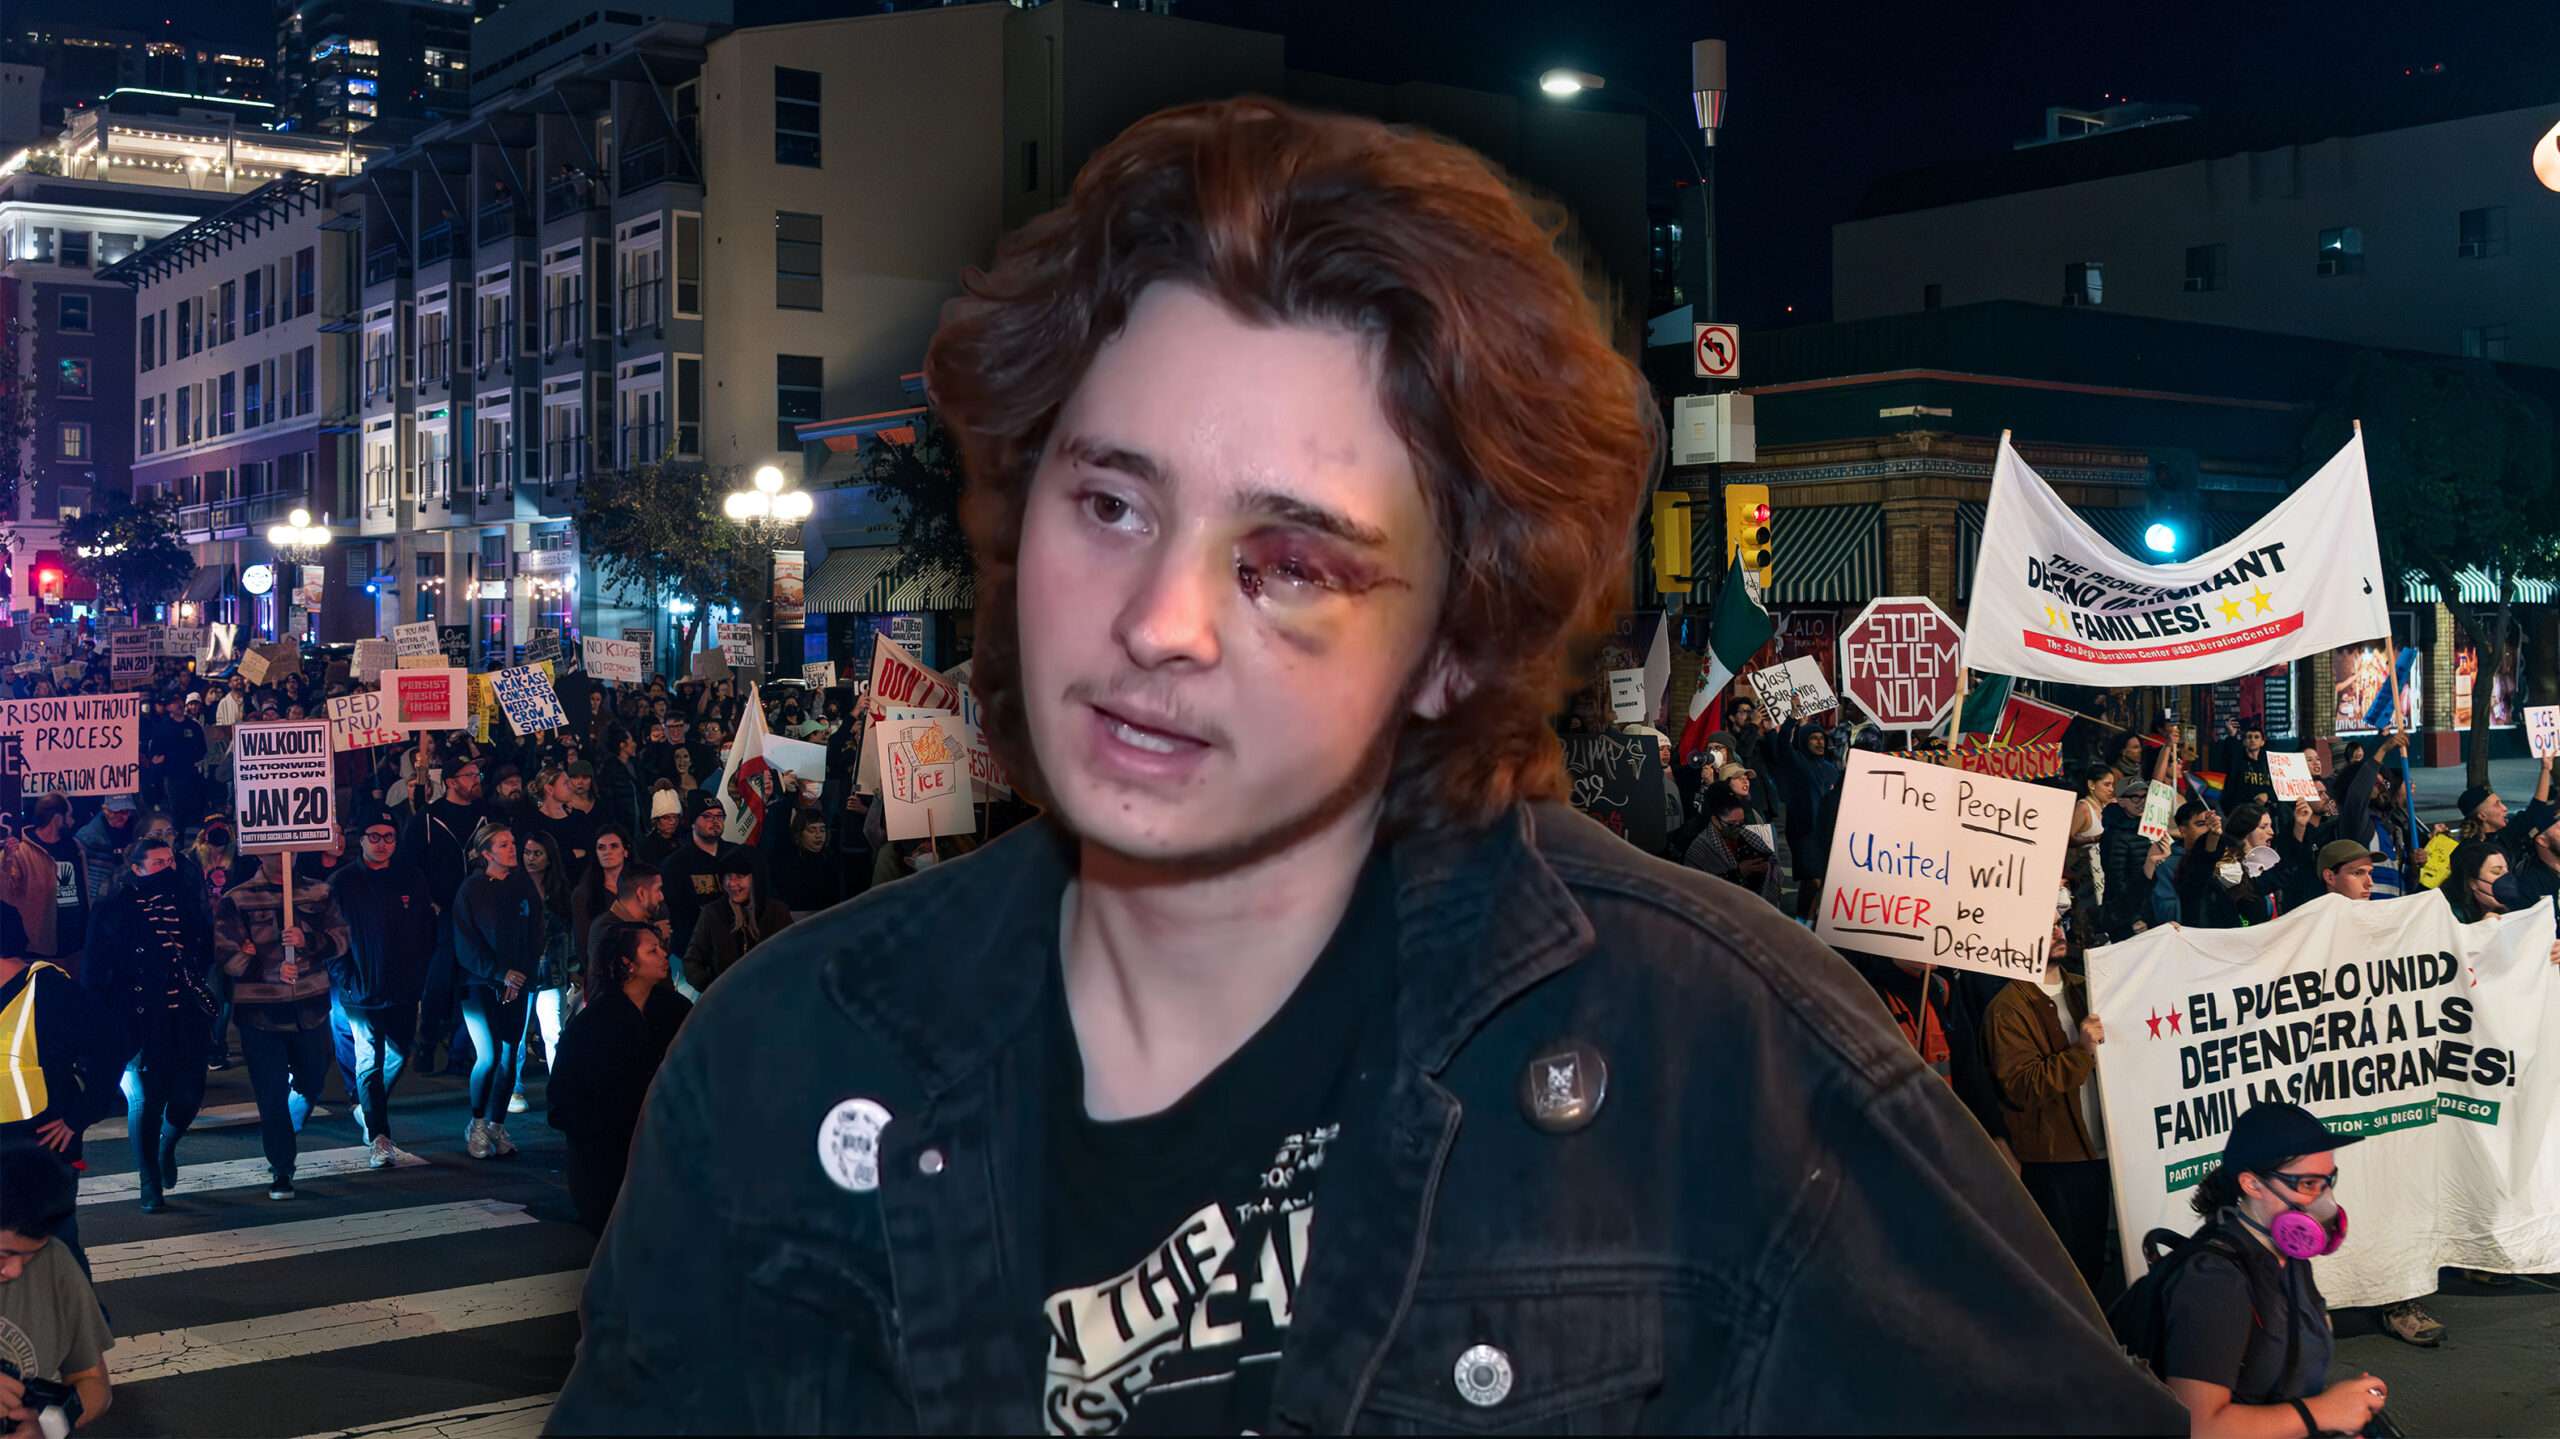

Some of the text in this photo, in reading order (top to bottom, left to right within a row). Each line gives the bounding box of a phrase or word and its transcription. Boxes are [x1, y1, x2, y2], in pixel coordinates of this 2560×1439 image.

[2048, 553, 2089, 577] THE
[2090, 569, 2156, 597] PEOPLE
[1868, 612, 1938, 643] STOP
[2071, 603, 2211, 641] FAMILIES!
[587, 640, 602, 655] NO
[1850, 641, 1960, 679] FASCISM
[493, 672, 547, 693] WEAK-ASS
[501, 666, 530, 679] OUR
[73, 697, 141, 721] WITHOUT
[505, 692, 557, 714] NEEDS TO
[1875, 678, 1937, 718] NOW
[512, 705, 562, 723] GROW A
[520, 715, 562, 733] SPINE
[36, 725, 123, 751] PROCESS
[241, 730, 322, 757] WALKOUT!
[100, 763, 140, 789] CAMP
[240, 761, 326, 772] NATIONWIDE
[240, 770, 326, 781] SHUTDOWN
[1962, 750, 2059, 779] FASCISM
[918, 772, 944, 792] ICE
[241, 786, 328, 828] JAN 20
[1867, 770, 2039, 833] The People
[1849, 831, 1950, 884] United
[1832, 887, 1985, 929] NEVER be
[1934, 925, 2044, 974] Defeated!
[2188, 951, 2459, 1034] EL PUEBLO UNIDO
[2386, 1003, 2408, 1033] A
[2391, 1108, 2423, 1124] DIEGO
[2169, 1163, 2200, 1184] PARTY
